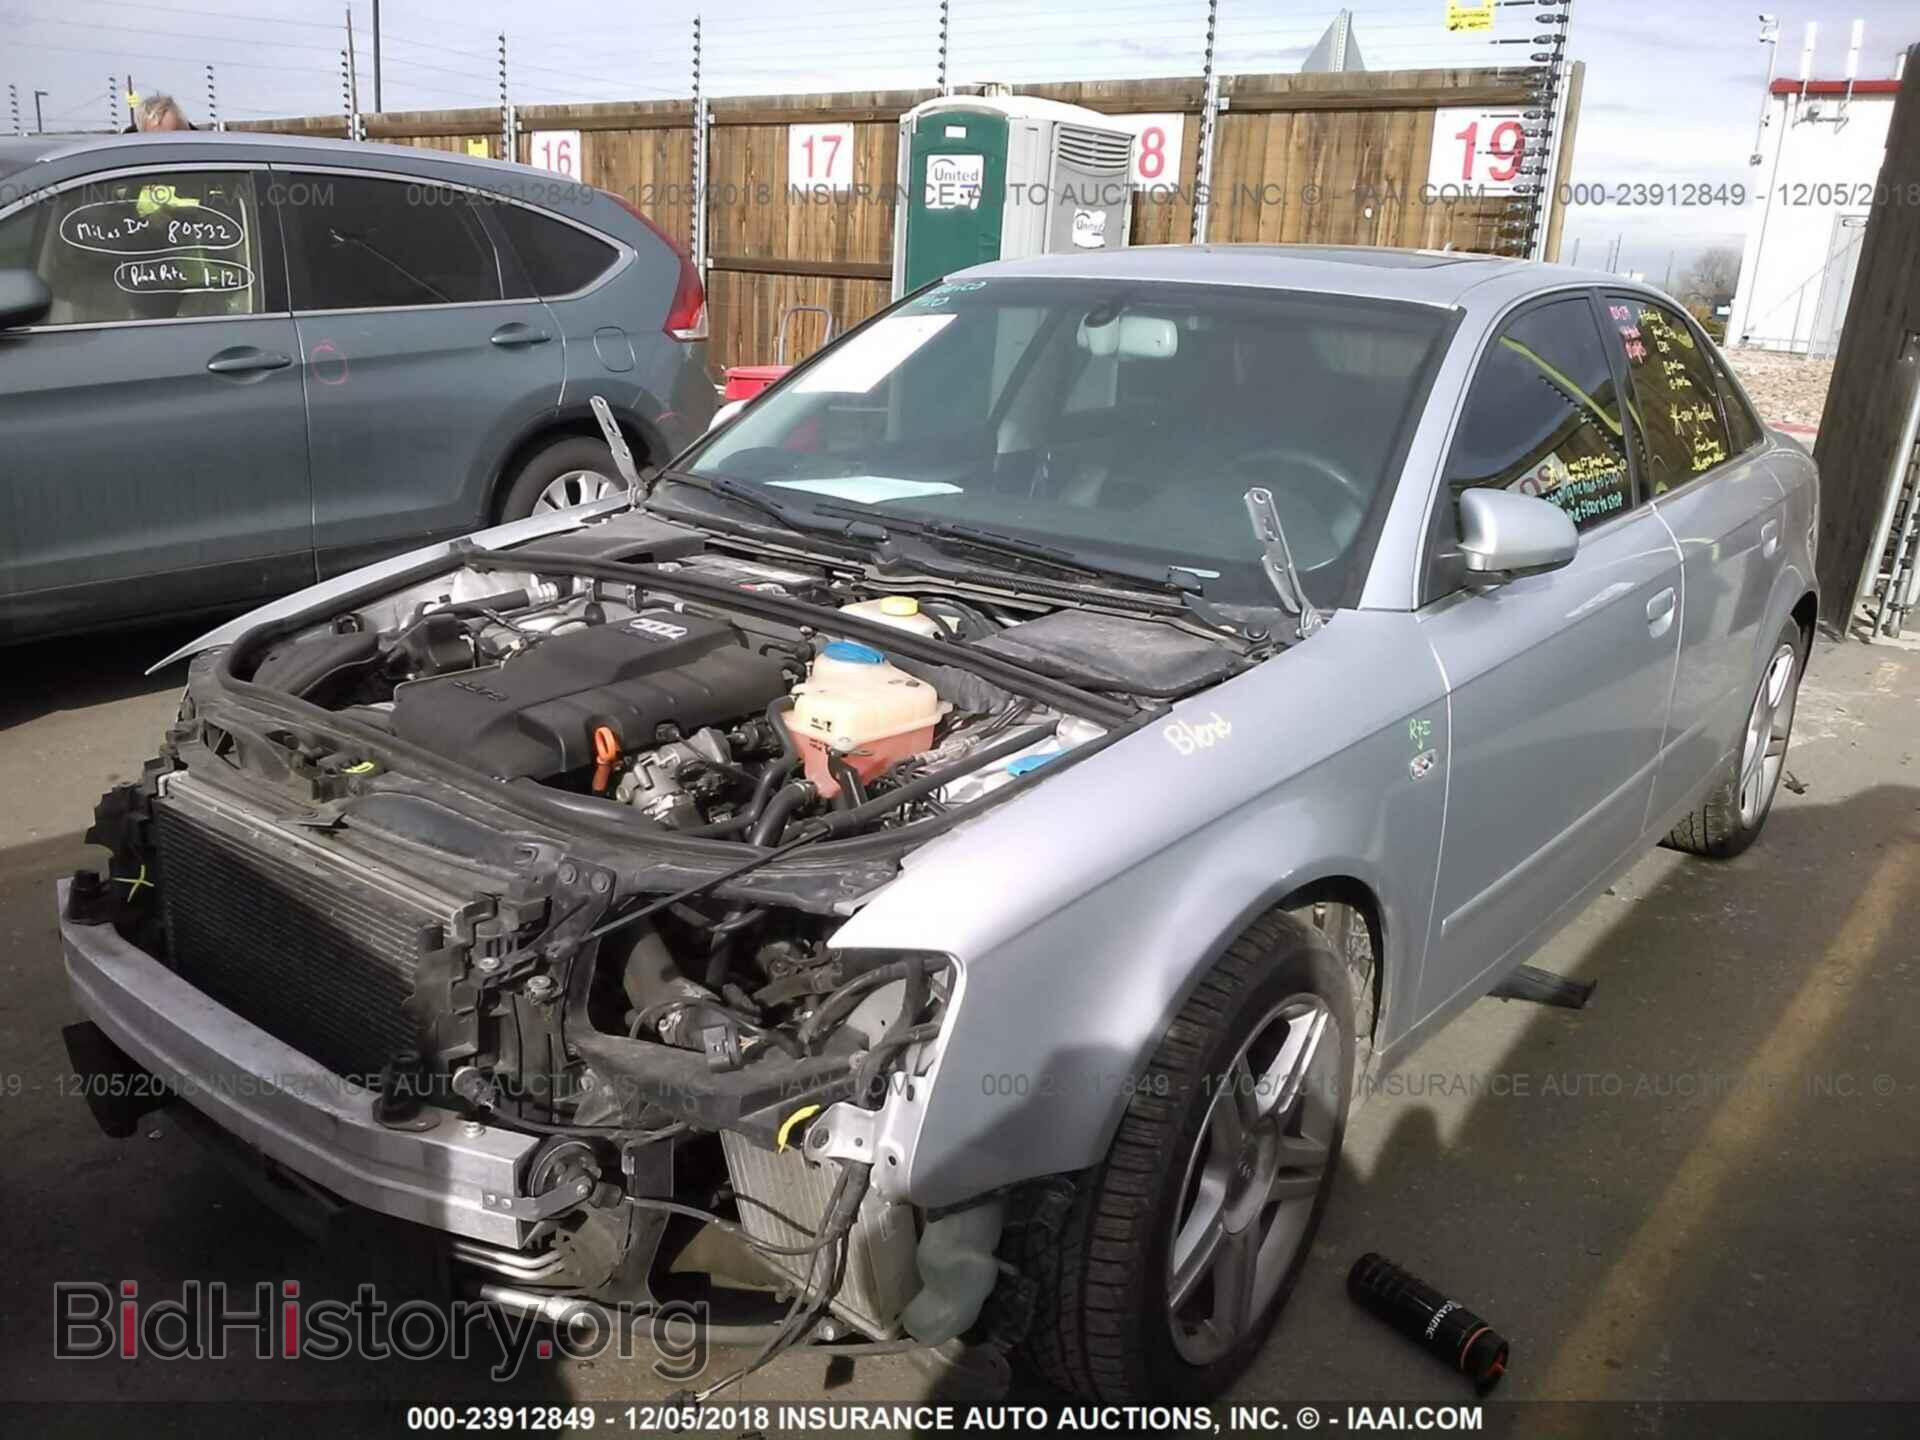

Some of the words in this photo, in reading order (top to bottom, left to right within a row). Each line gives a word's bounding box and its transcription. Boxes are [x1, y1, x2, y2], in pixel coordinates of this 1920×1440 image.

[541, 139, 573, 177] 16
[801, 134, 843, 178] 17
[1138, 126, 1166, 178] 8
[1454, 119, 1526, 182] 19
[934, 167, 979, 182] United
[168, 219, 231, 243] 80532
